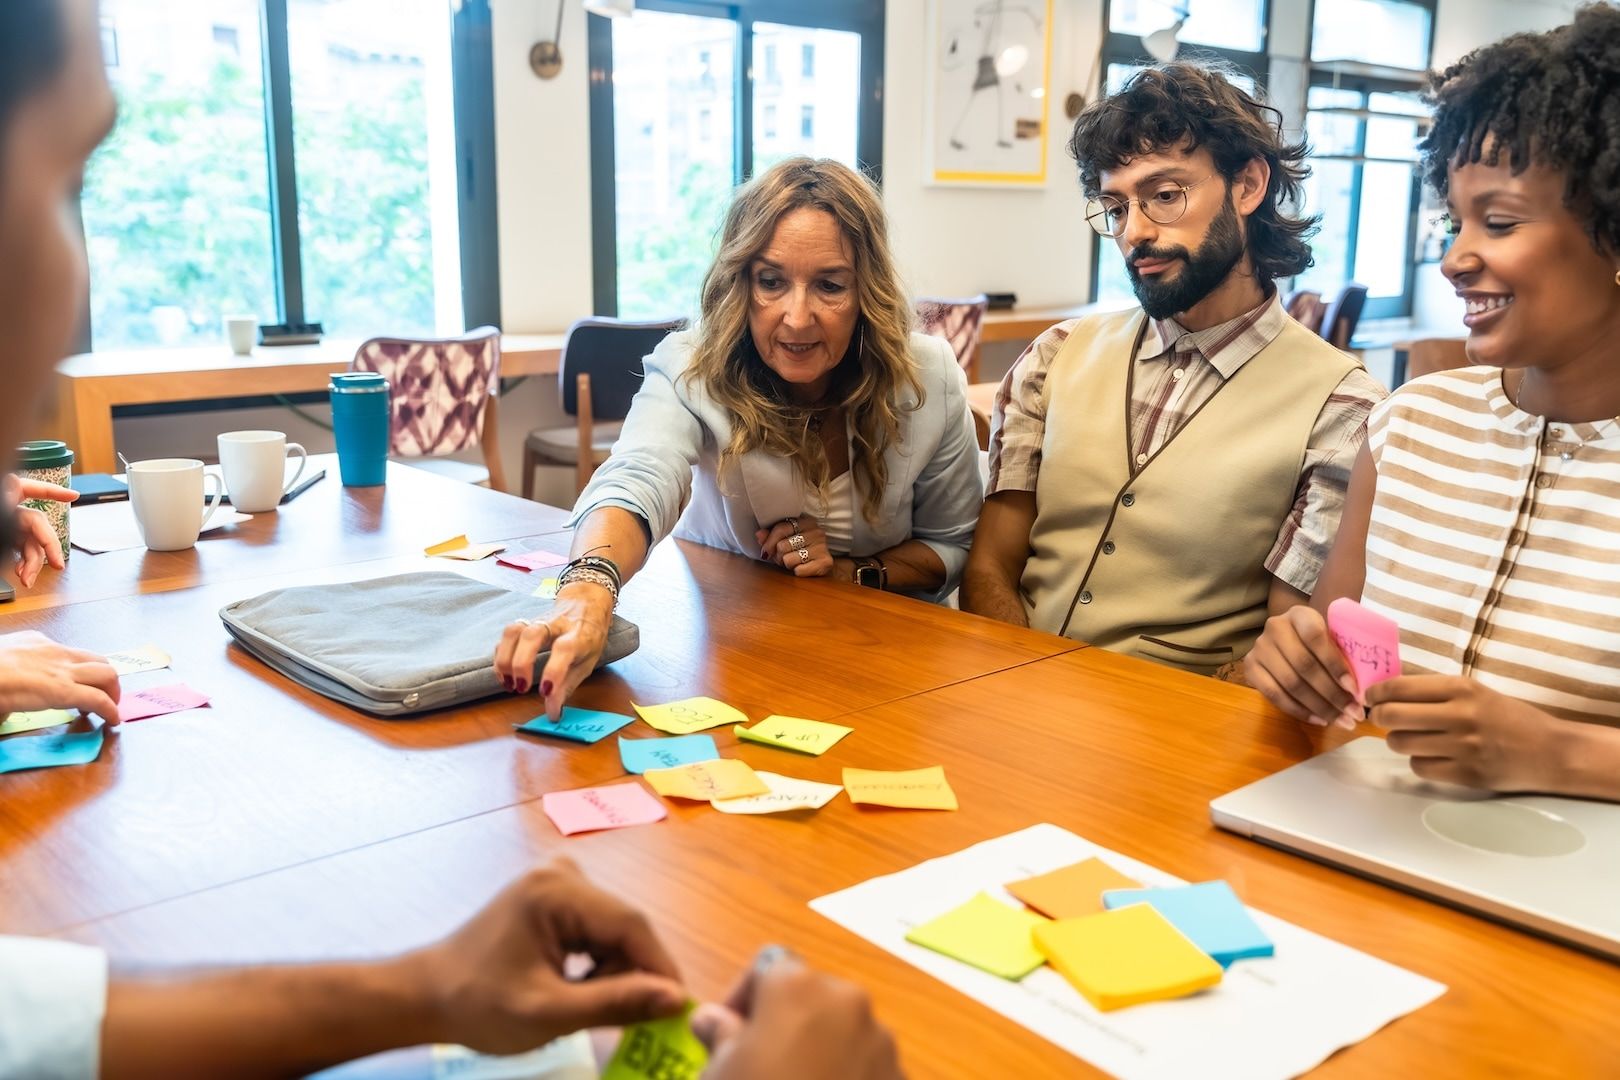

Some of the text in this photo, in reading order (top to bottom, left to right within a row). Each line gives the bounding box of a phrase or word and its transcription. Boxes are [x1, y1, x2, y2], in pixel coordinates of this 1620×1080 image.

[669, 706, 713, 725] ECO
[554, 722, 605, 734] TEAM
[796, 733, 821, 743] UP
